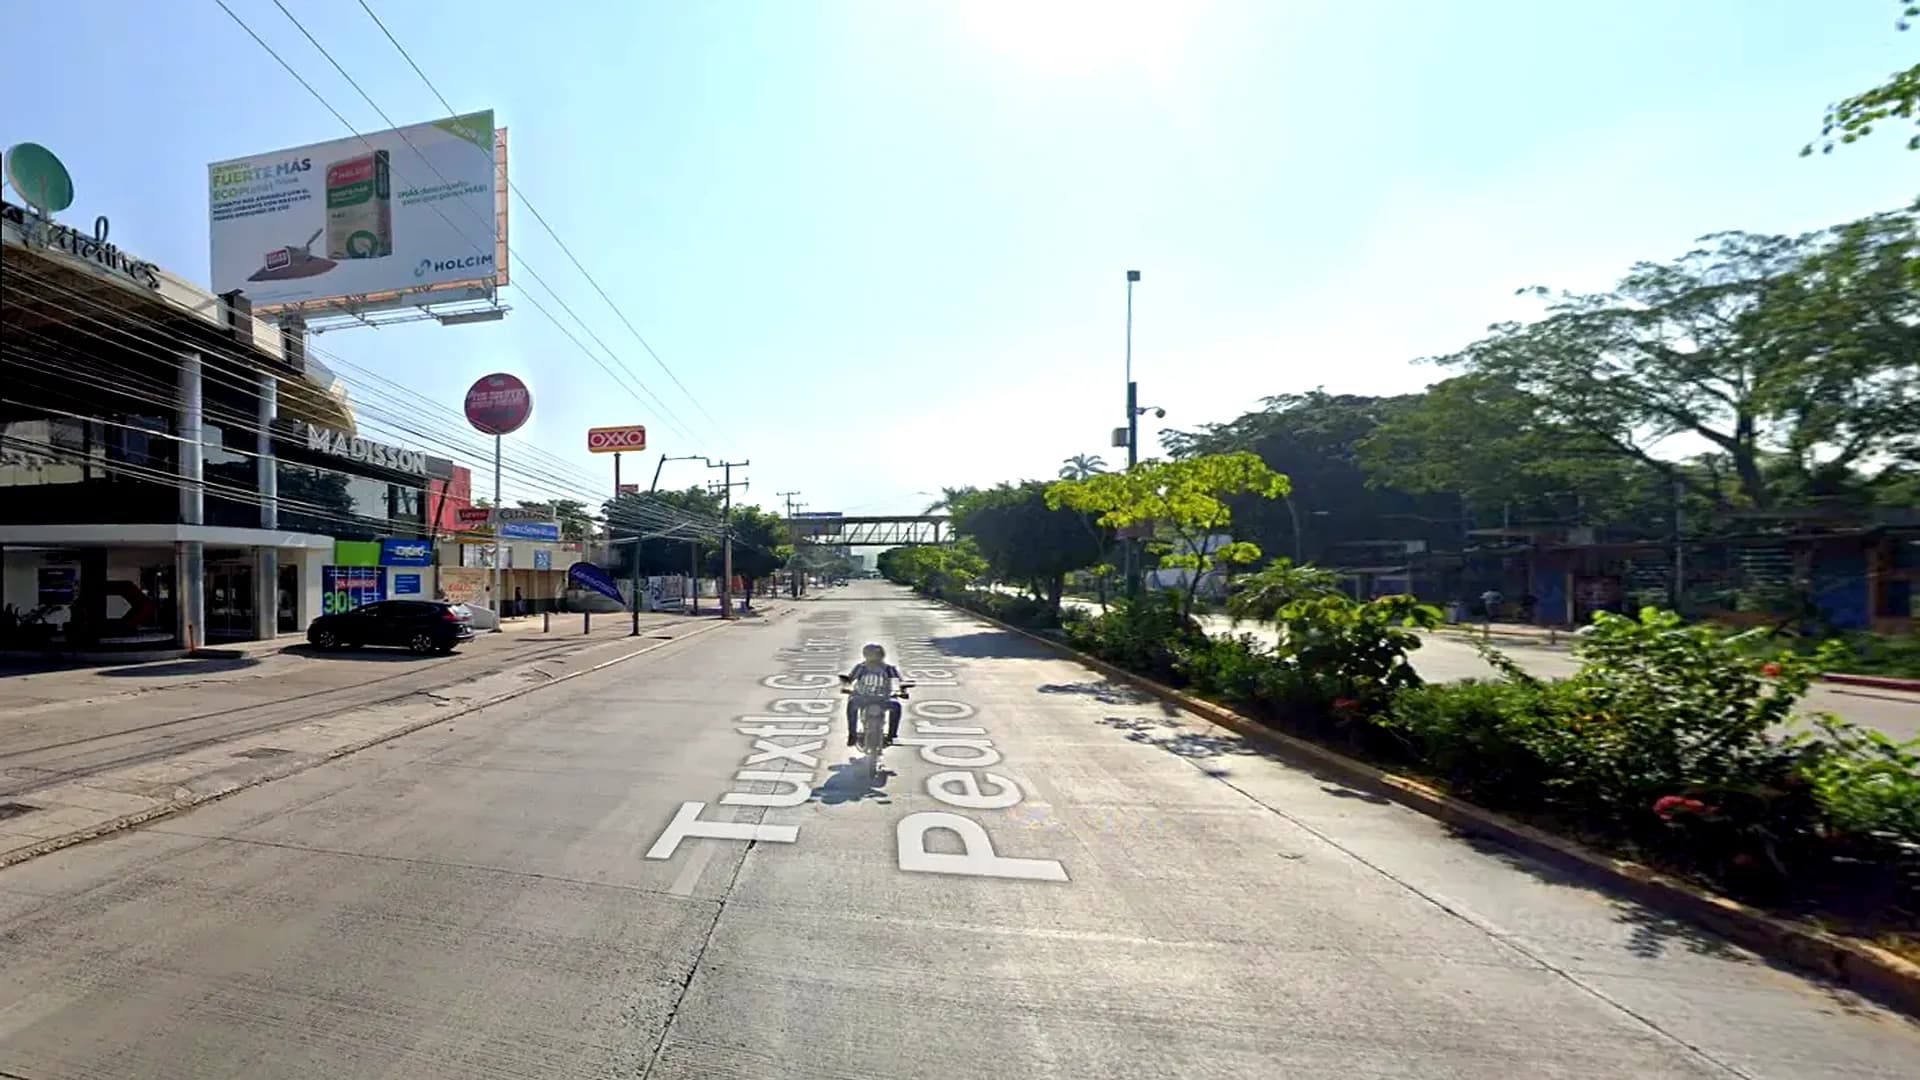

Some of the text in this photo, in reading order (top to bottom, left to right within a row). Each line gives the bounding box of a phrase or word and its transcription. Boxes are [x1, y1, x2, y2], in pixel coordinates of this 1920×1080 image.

[213, 157, 312, 188] FUERTE MÁS
[434, 255, 493, 272] HOLCIM
[307, 423, 427, 475] MADISSON
[591, 431, 642, 448] OXXO
